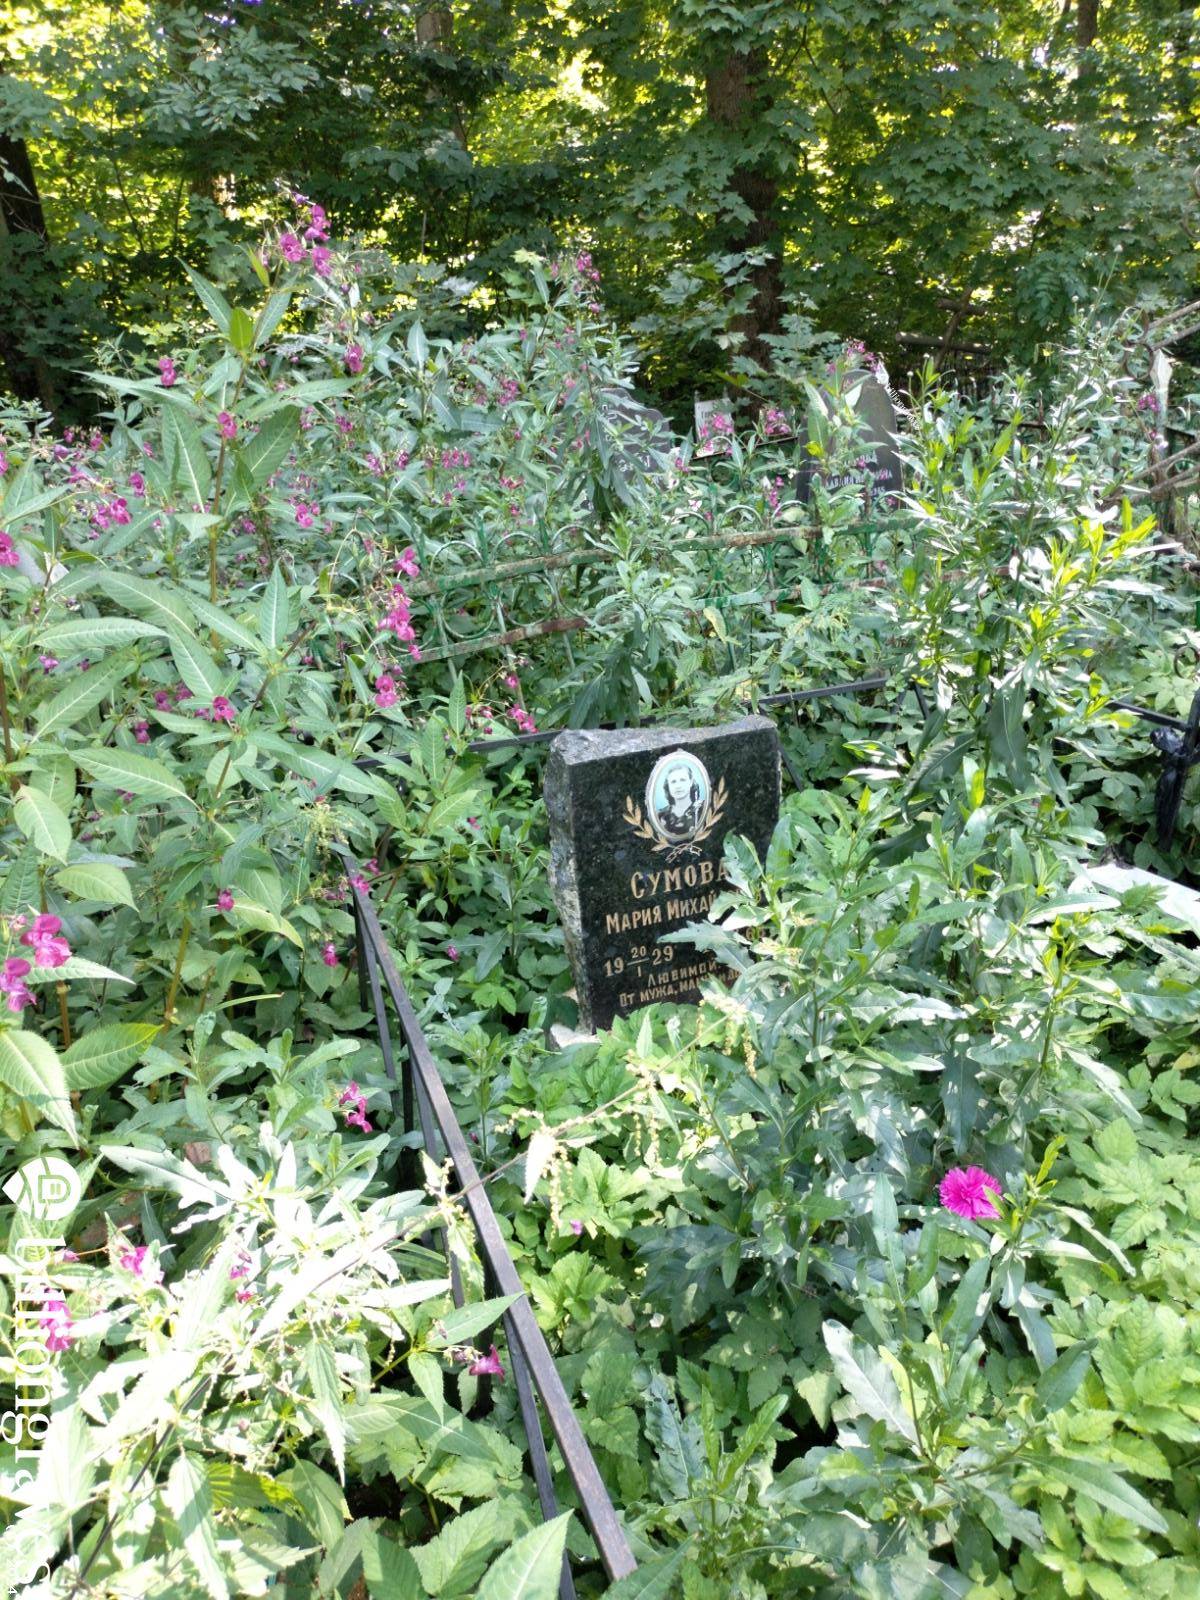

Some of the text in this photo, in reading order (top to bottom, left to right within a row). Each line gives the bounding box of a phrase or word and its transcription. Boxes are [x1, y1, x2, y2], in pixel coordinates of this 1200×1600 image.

[630, 860, 731, 899] СУМОВА
[605, 904, 662, 935] МАРИЯ
[603, 956, 625, 978] 19
[631, 945, 647, 957] 20
[651, 944, 674, 966] 29
